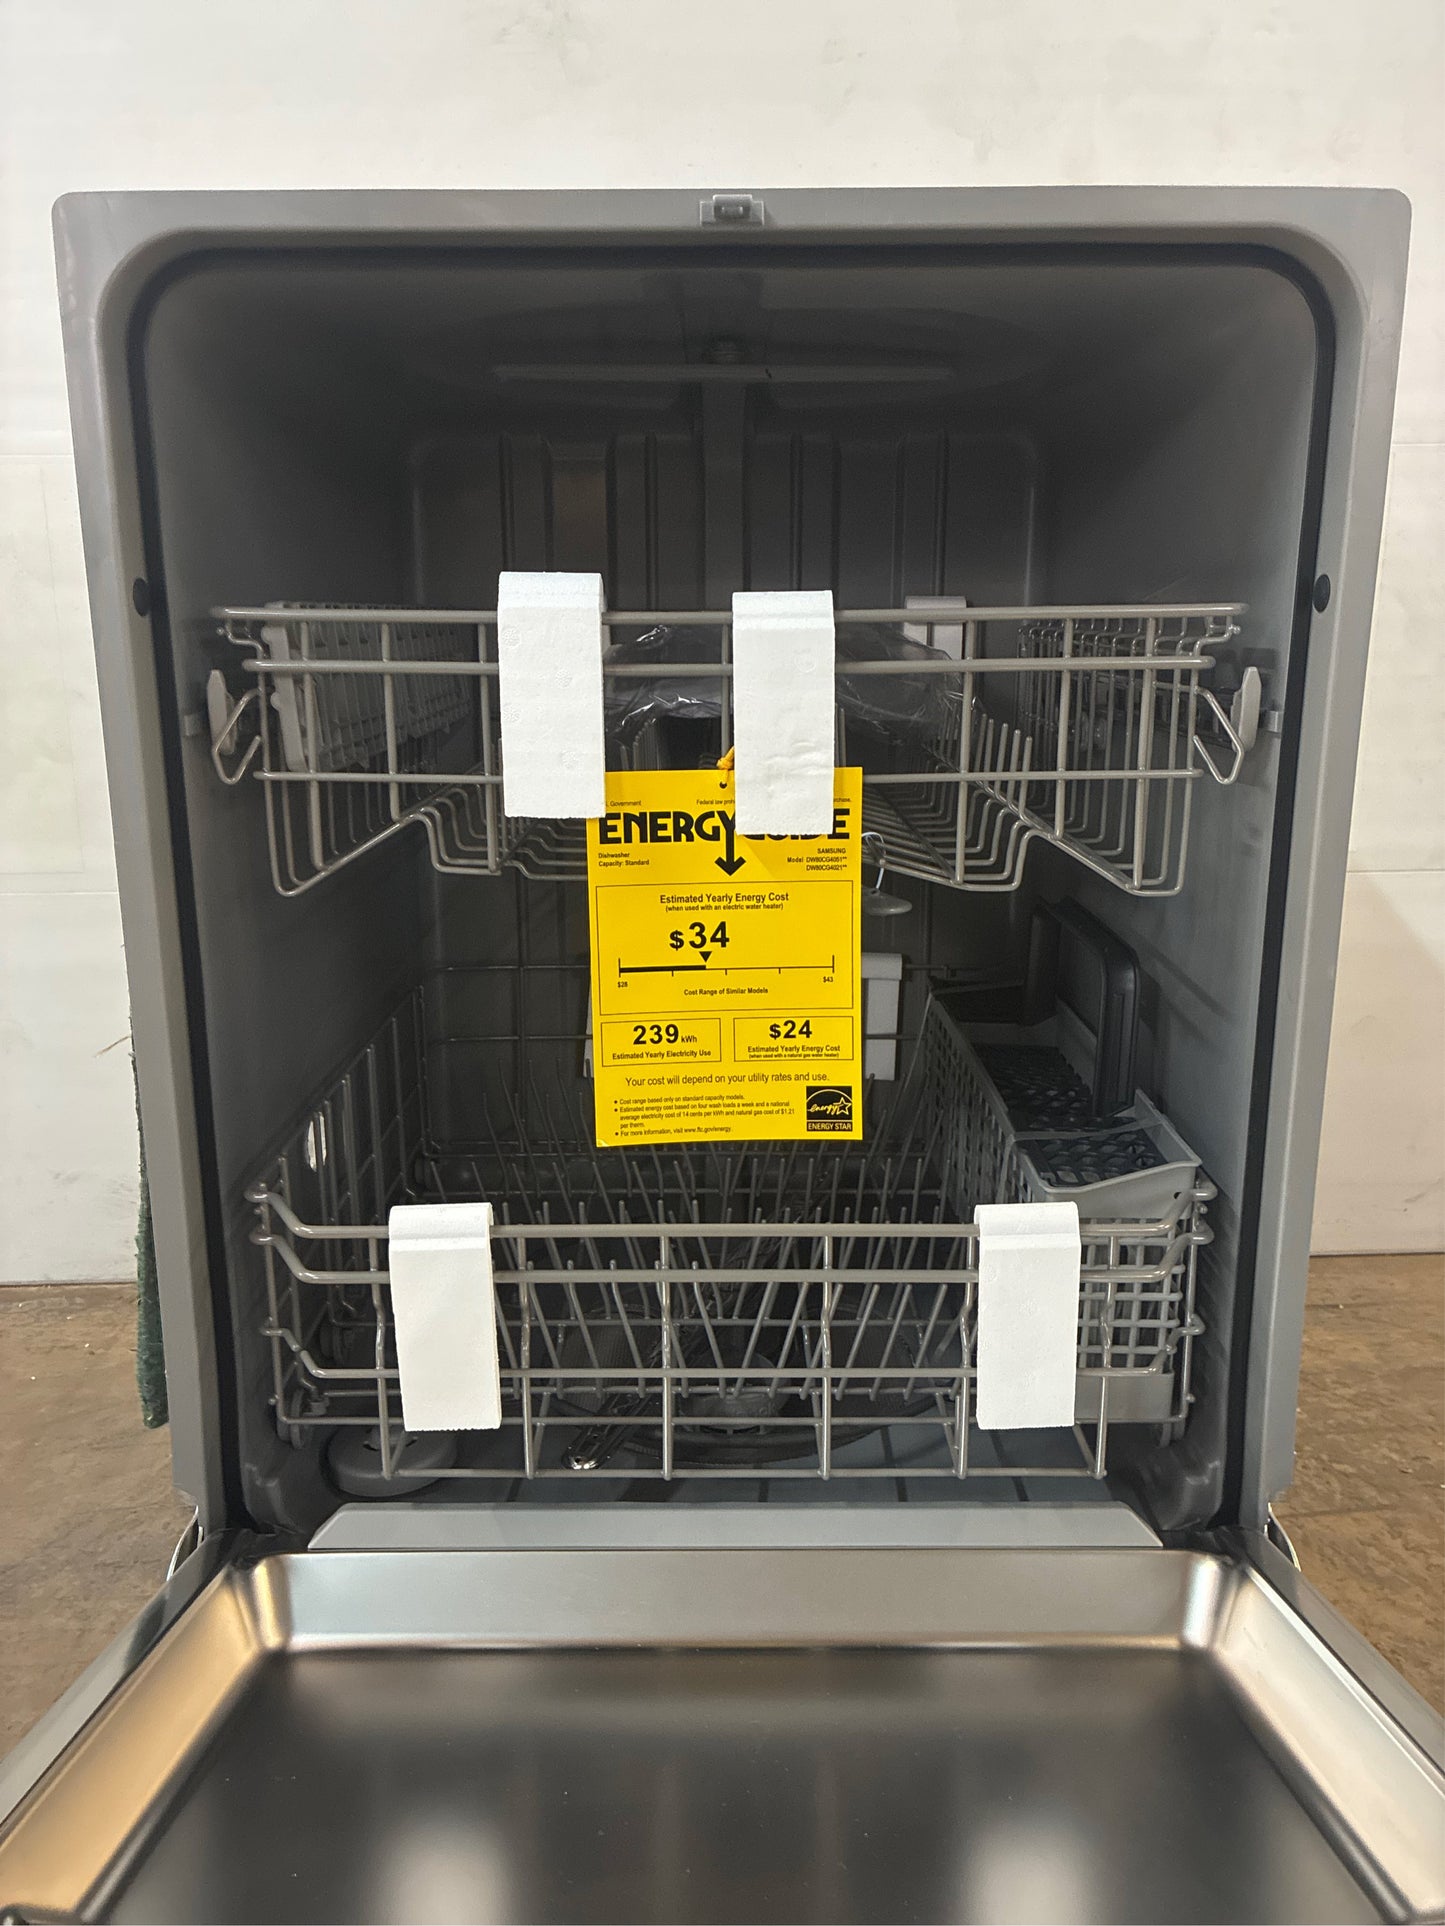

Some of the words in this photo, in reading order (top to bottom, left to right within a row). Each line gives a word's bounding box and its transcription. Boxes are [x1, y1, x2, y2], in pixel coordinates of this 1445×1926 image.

[599, 808, 850, 844] ENERGYE
[660, 894, 703, 904] Estimated
[706, 893, 733, 904] Yearly
[736, 893, 766, 903] Energy
[768, 892, 789, 901] Cost
[669, 921, 730, 951] $34
[633, 1024, 679, 1045] 239
[769, 1020, 812, 1040] $24
[802, 1045, 824, 1053] Energy
[626, 1077, 645, 1086] Your
[648, 1077, 665, 1086] cost
[667, 1075, 680, 1085] will
[682, 1074, 712, 1085] depend
[728, 1075, 746, 1084] your
[748, 1073, 769, 1084] utility
[794, 1072, 809, 1081] and
